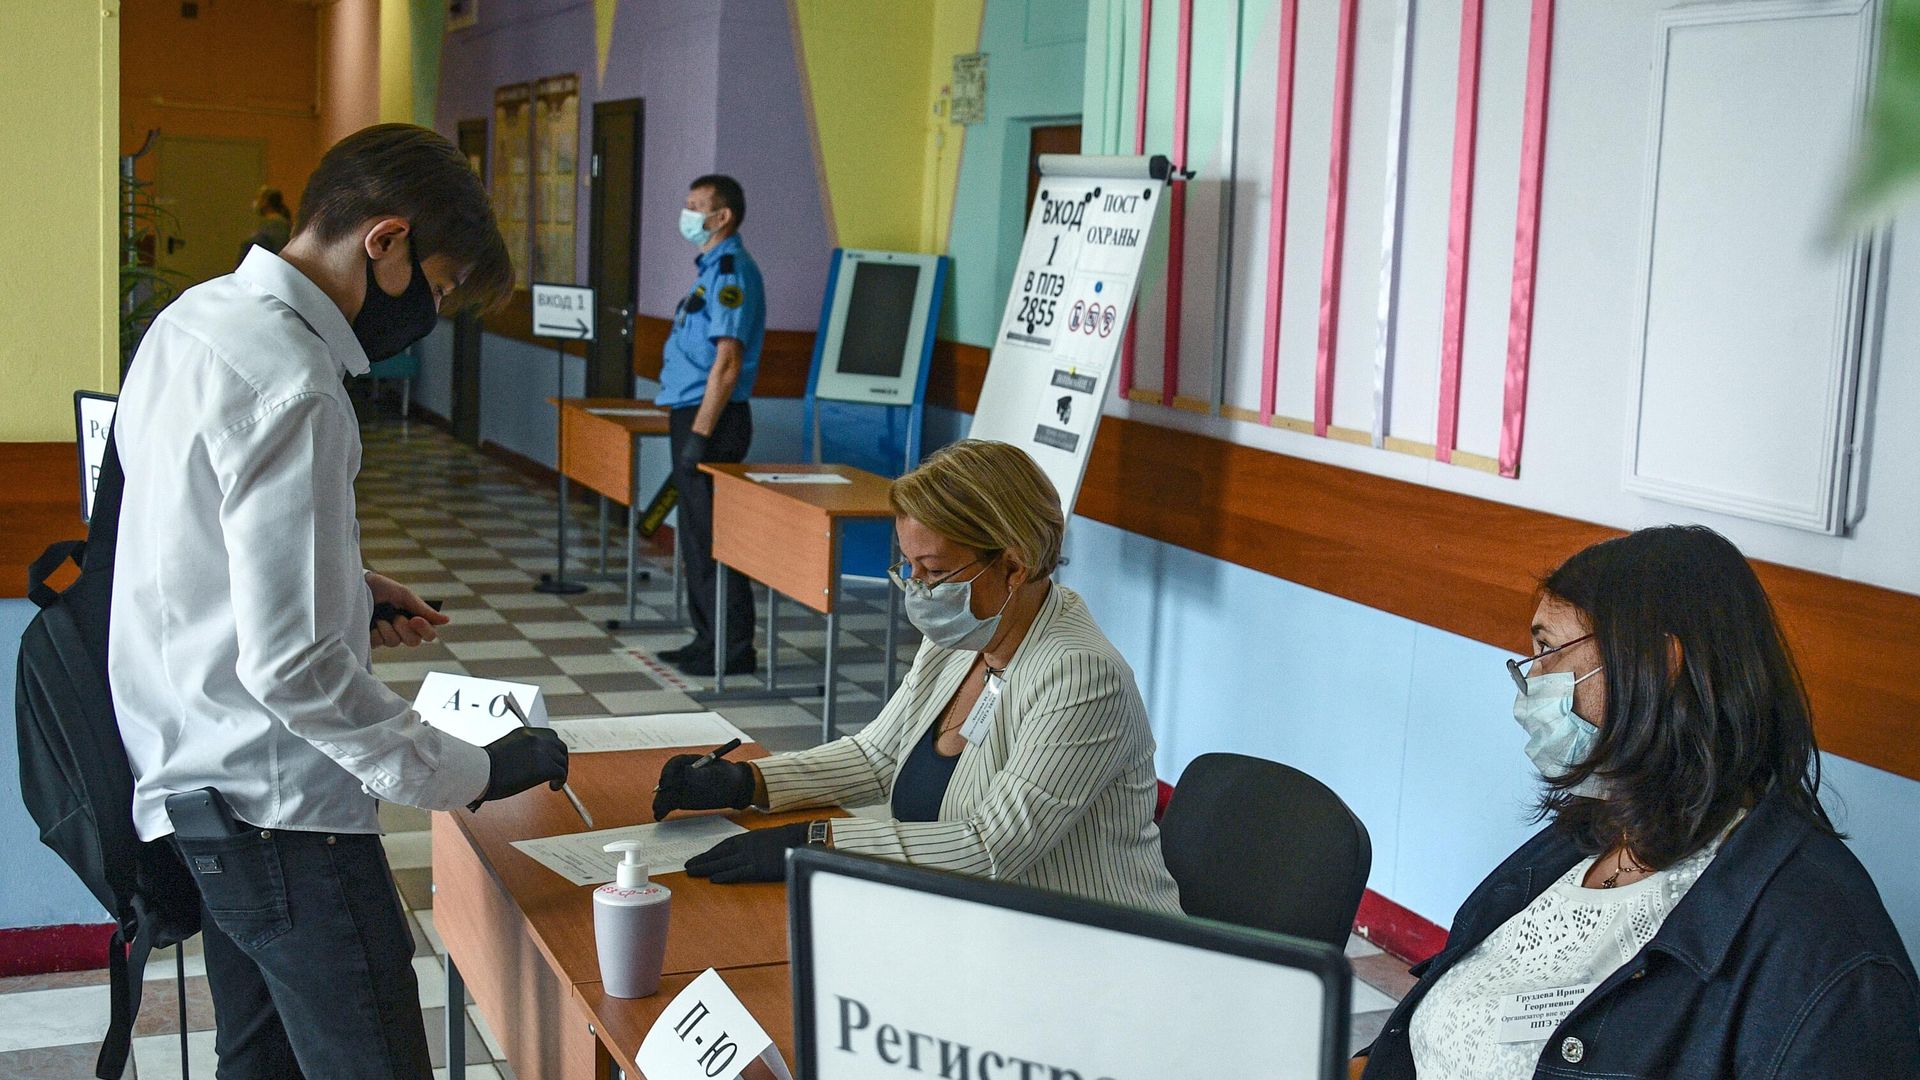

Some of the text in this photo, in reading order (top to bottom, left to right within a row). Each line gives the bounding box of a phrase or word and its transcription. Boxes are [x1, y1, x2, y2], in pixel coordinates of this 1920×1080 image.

[1103, 194, 1140, 214] ПОСТ
[1042, 199, 1086, 232] ВХОД
[1086, 226, 1141, 247] ОХРАНЫ
[1046, 235, 1060, 266] 1
[1024, 270, 1065, 297] В ППЭ
[576, 294, 584, 311] 1
[1016, 295, 1057, 327] 2855
[1556, 988, 1585, 998] Ирина
[1524, 1000, 1574, 1011] Георгиевна
[1501, 1012, 1545, 1023] Организатор
[1530, 1019, 1553, 1028] ППЭ
[833, 994, 1117, 1080] Регист
